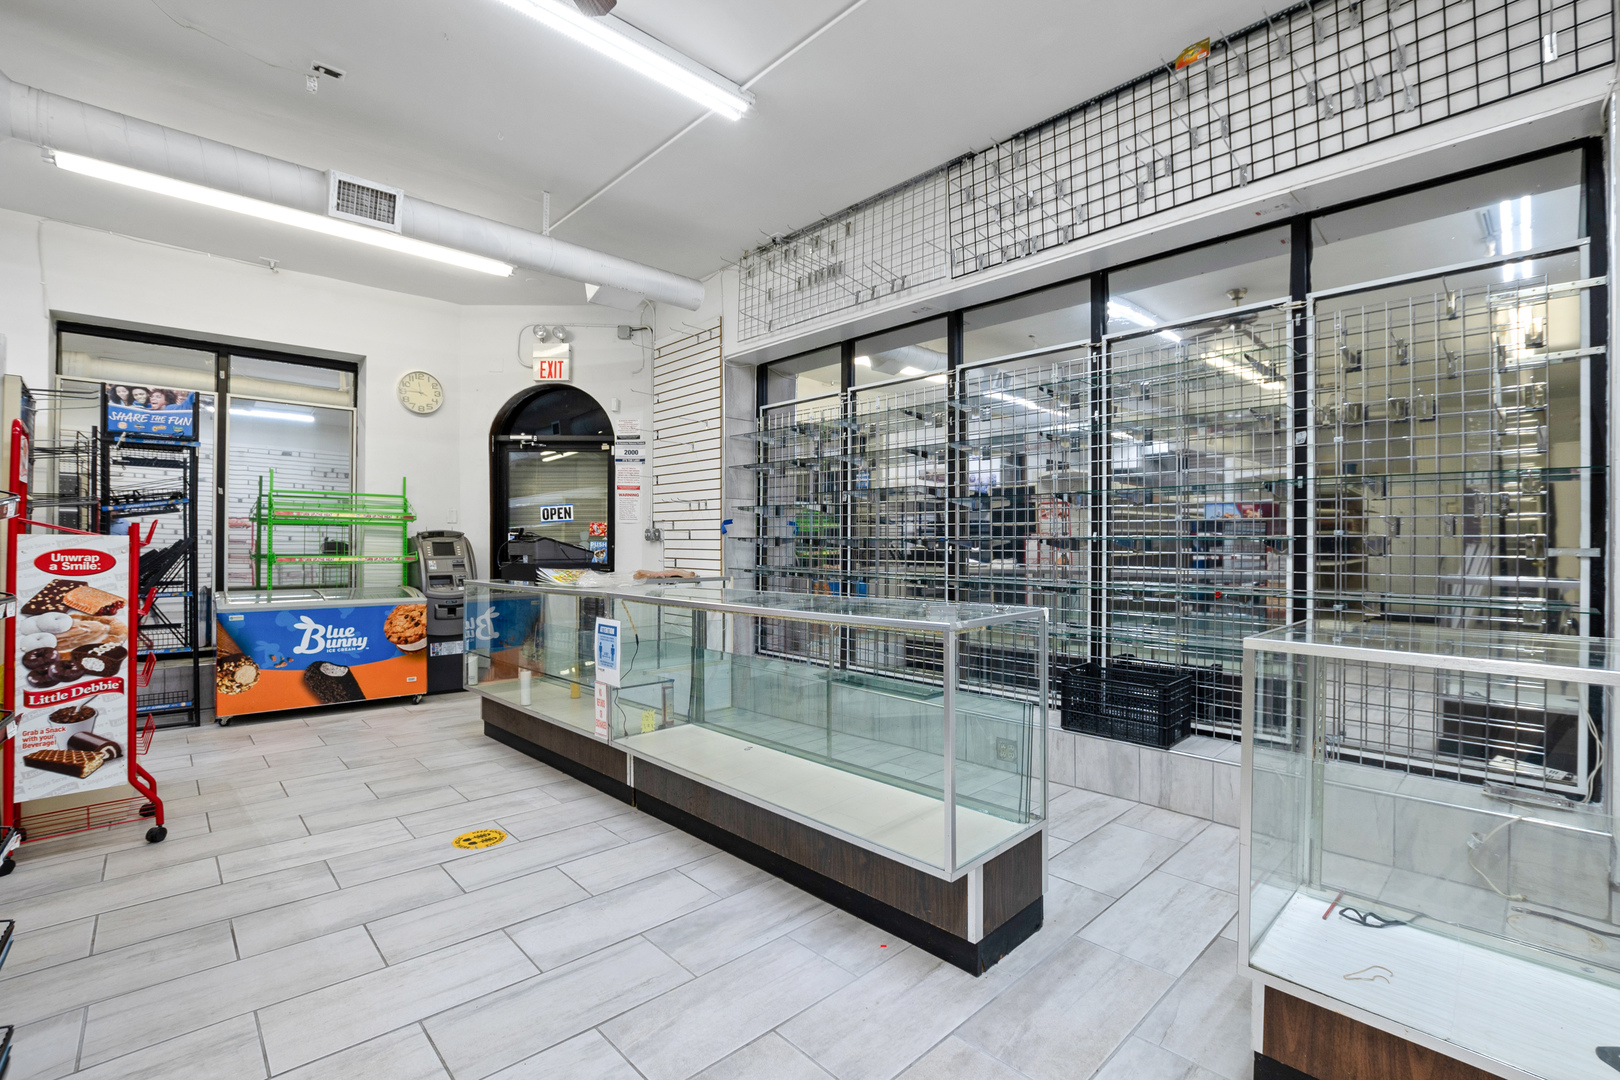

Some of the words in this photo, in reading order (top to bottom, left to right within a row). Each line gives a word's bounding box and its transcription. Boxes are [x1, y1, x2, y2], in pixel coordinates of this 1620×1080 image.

[540, 361, 564, 379] EXIT
[108, 411, 150, 423] SHARE
[150, 414, 167, 423] THE
[168, 416, 192, 426] FUN
[542, 506, 572, 521] OPEN
[51, 553, 100, 563] Unwrap
[49, 563, 58, 571] a
[61, 562, 102, 571] Smile:
[293, 615, 355, 648] Blue
[293, 628, 368, 654] Bunny
[28, 692, 68, 705] Little
[71, 680, 119, 698] Debbie
[45, 726, 67, 734] Snack
[22, 740, 57, 749] Beverage!
[39, 734, 55, 742] your
